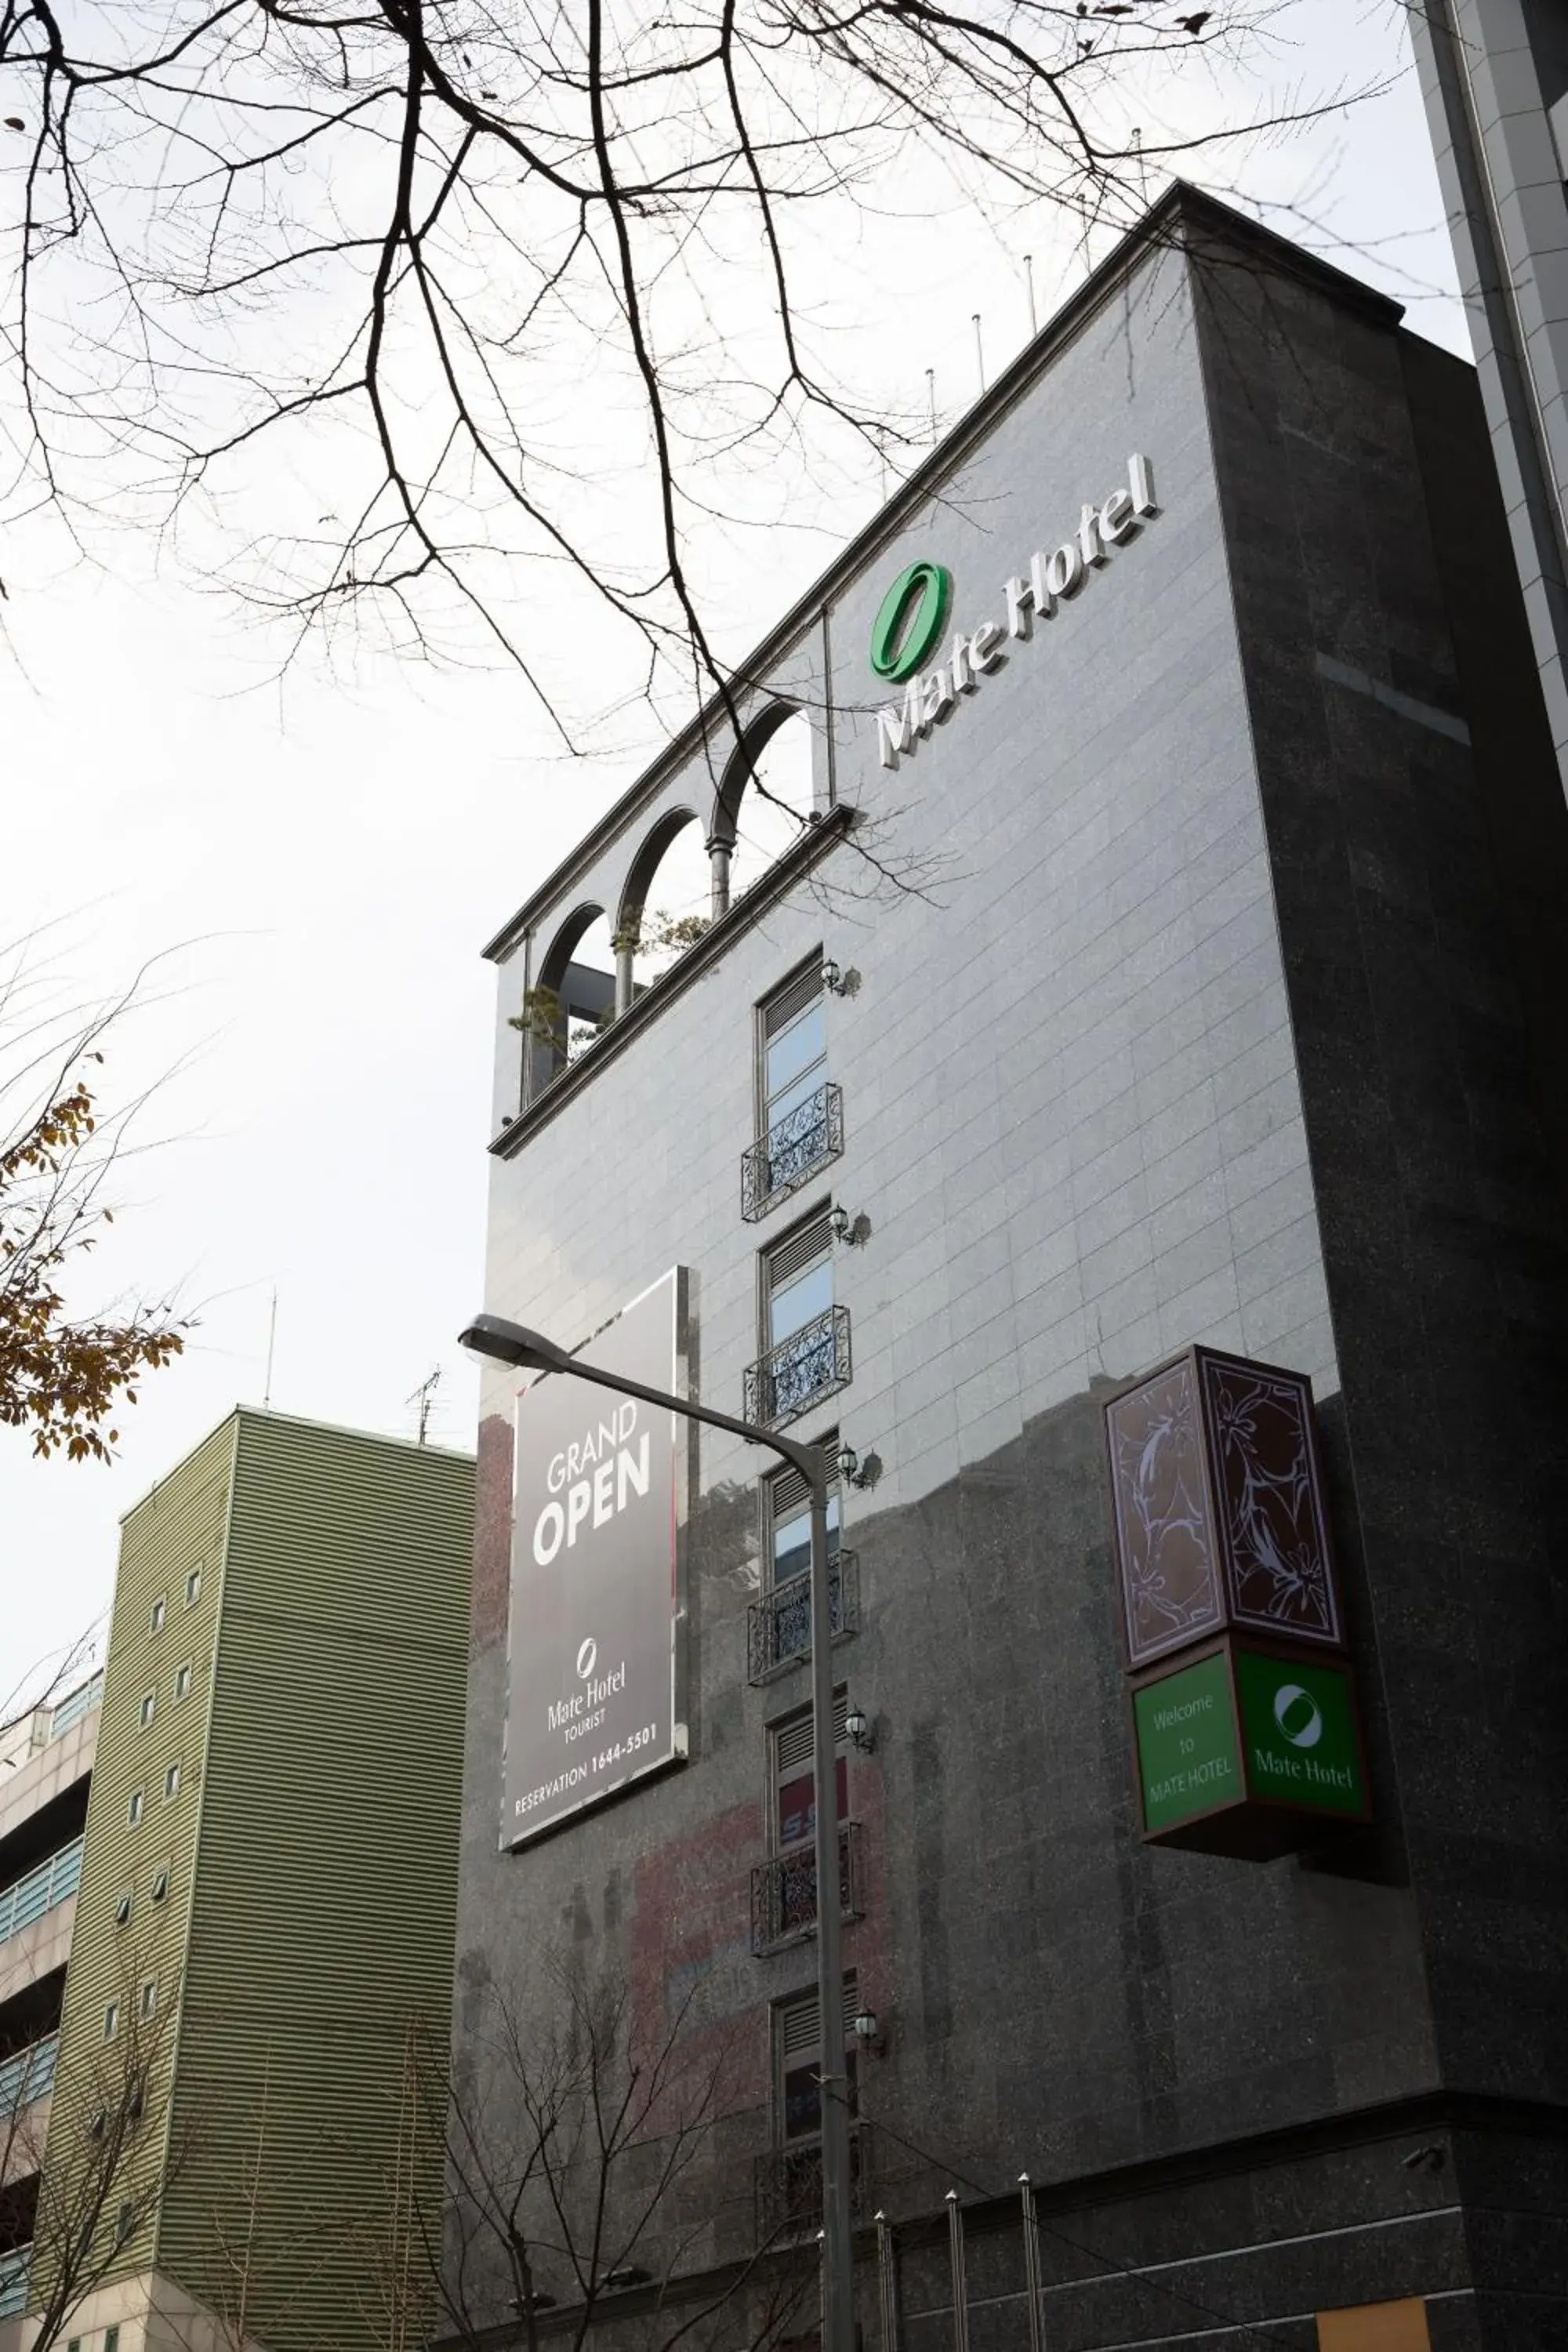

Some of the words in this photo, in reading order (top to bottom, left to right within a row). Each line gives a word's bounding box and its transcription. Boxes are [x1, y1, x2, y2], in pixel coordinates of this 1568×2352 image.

[872, 620, 1005, 769] Mate
[1001, 452, 1156, 640] Hotel
[547, 1399, 637, 1493] GRAND
[533, 1432, 649, 1566] OPEN
[548, 1693, 584, 1731] Mate
[586, 1660, 626, 1708] Hotel
[1154, 1694, 1213, 1731] Welcome
[564, 1708, 605, 1744] TOURIST
[1179, 1737, 1195, 1755] to
[515, 1762, 588, 1816] RESERVATION
[592, 1722, 656, 1773] 1644-5501
[1150, 1773, 1186, 1803] MATE
[1187, 1757, 1232, 1789] HOTEL
[1254, 1748, 1301, 1779] Mate
[1305, 1759, 1352, 1789] Hotel
